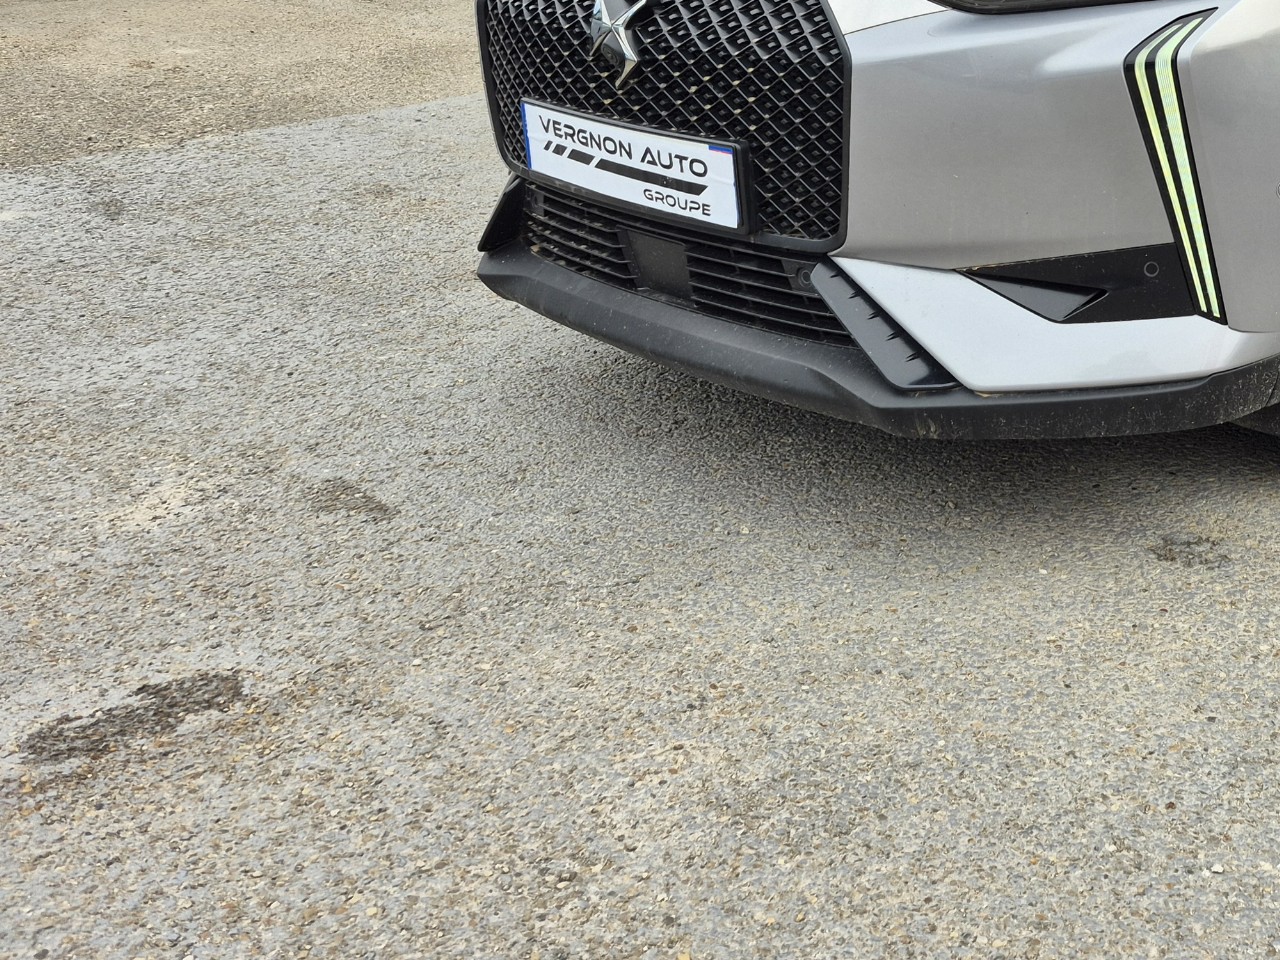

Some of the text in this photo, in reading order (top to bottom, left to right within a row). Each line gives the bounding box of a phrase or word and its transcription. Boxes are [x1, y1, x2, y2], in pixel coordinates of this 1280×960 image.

[538, 113, 708, 178] VERGNON AUTO
[643, 188, 712, 217] GROUPE
